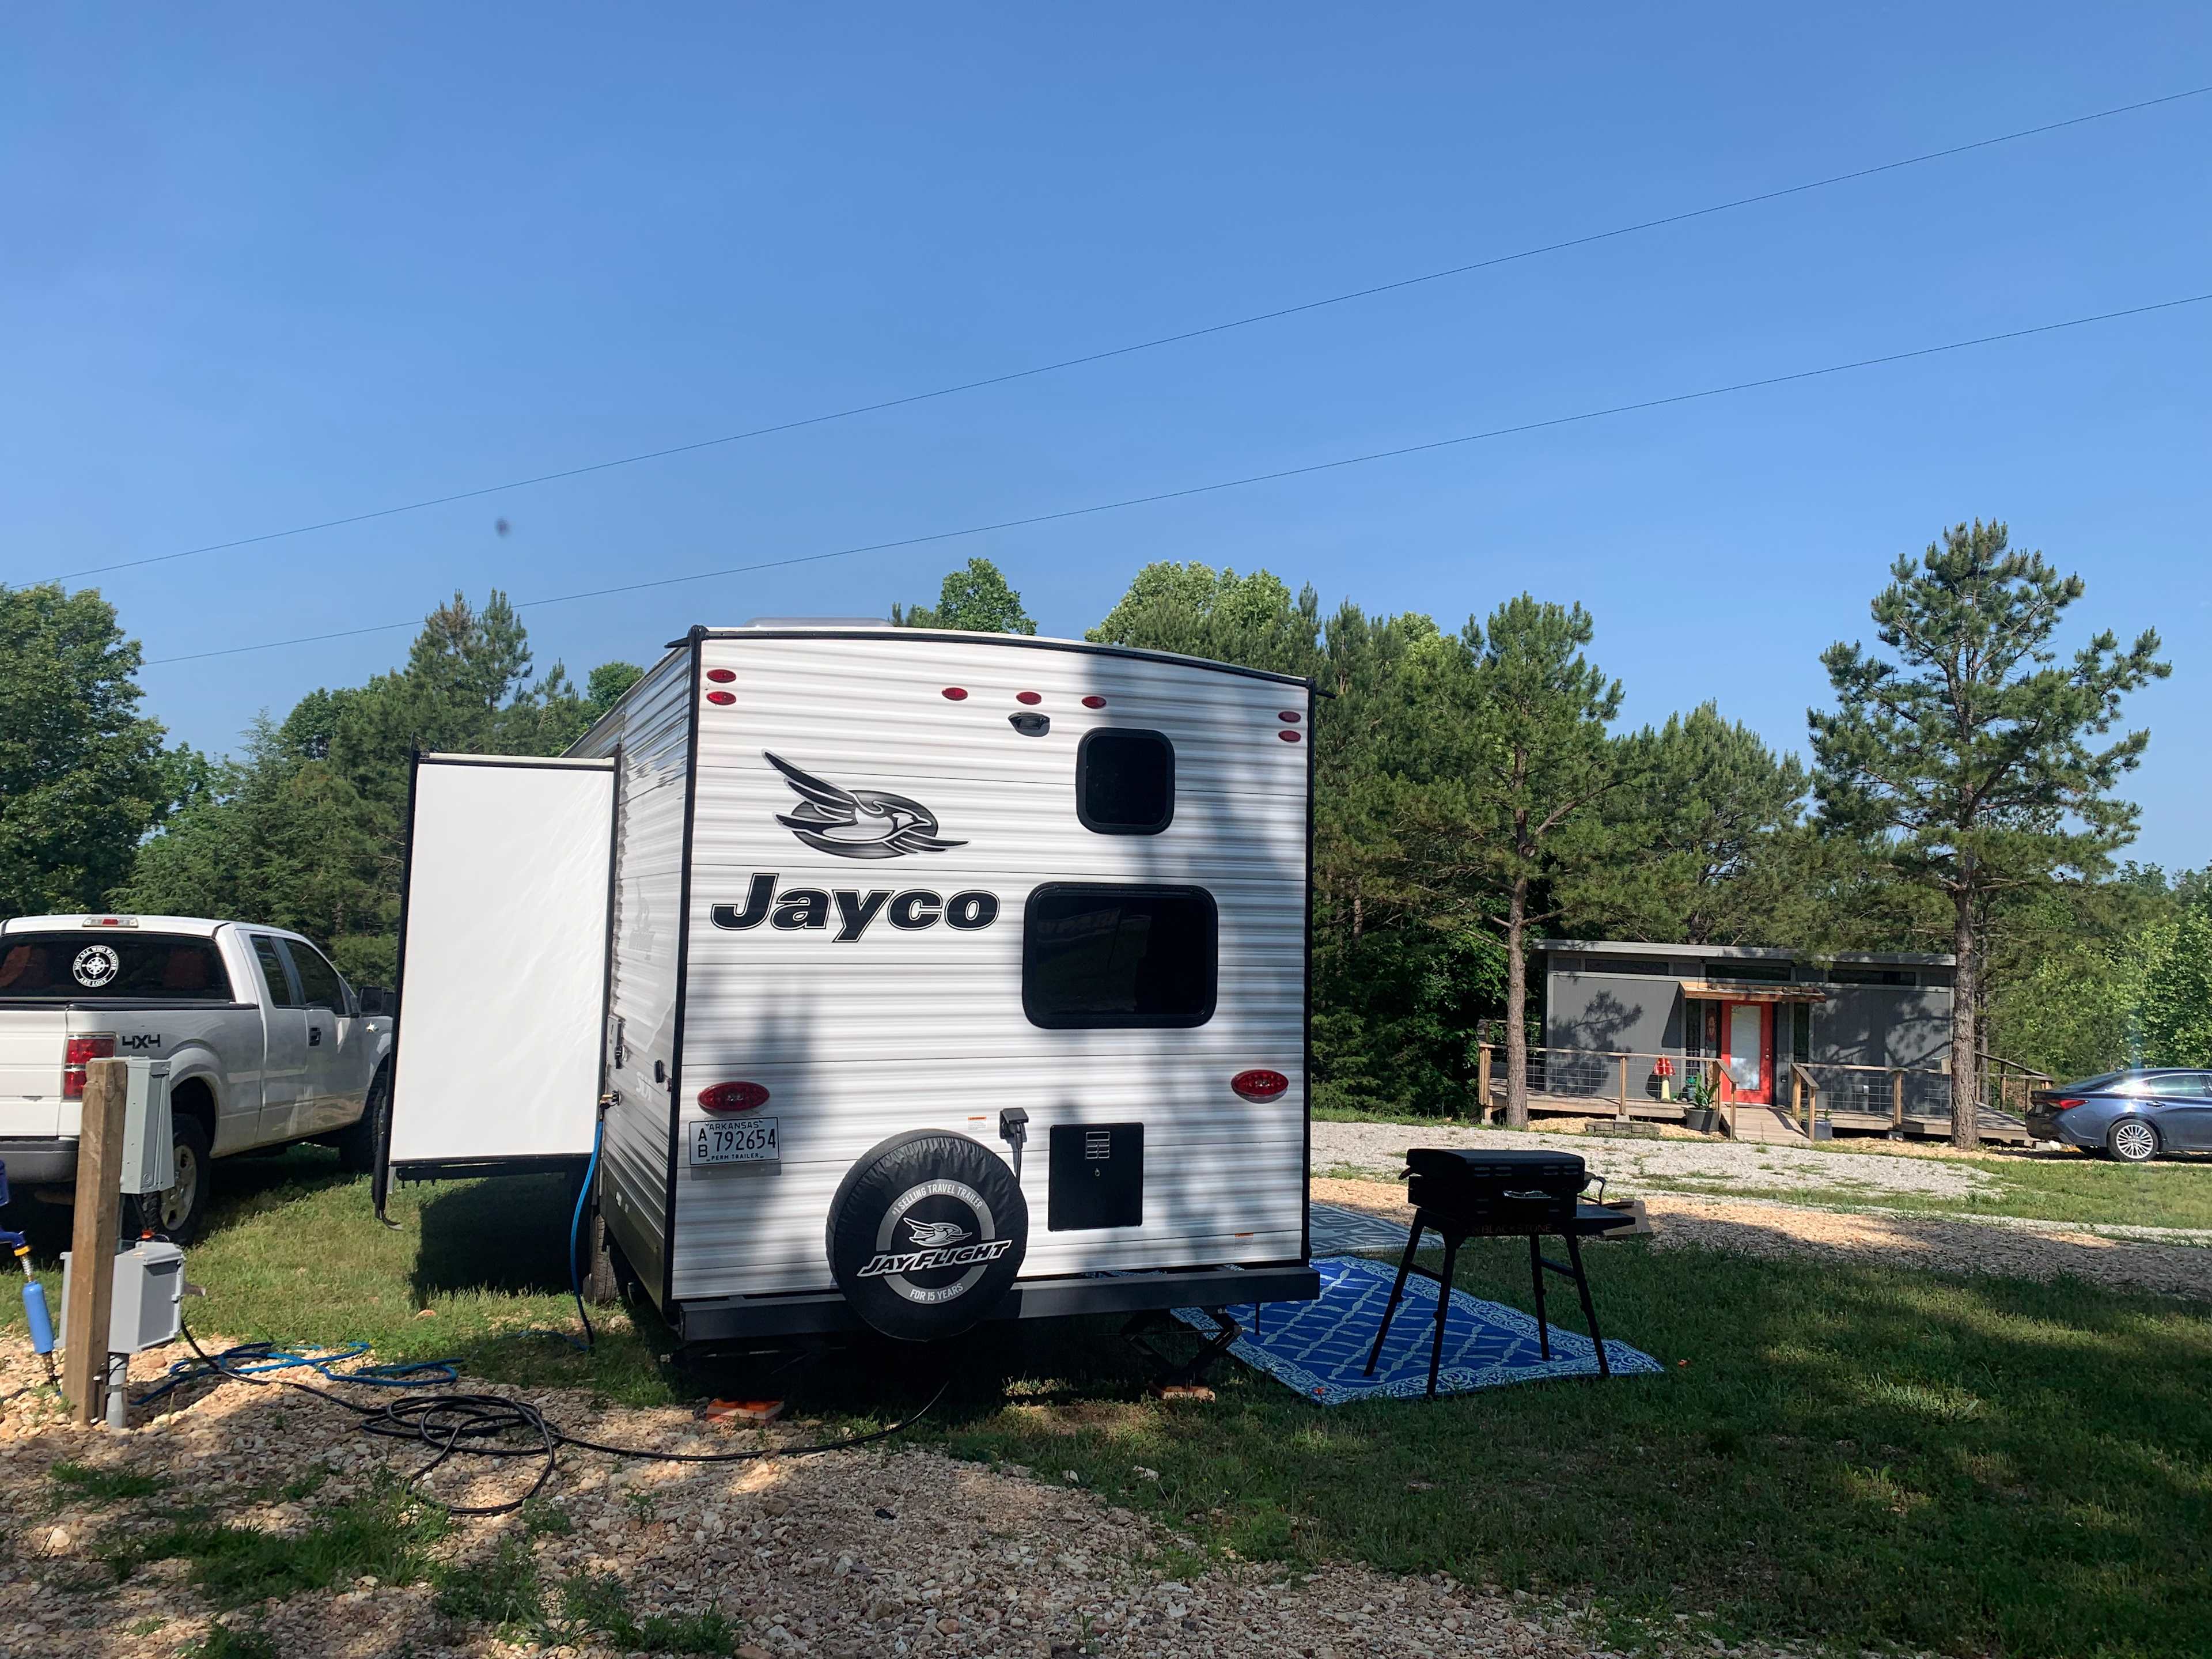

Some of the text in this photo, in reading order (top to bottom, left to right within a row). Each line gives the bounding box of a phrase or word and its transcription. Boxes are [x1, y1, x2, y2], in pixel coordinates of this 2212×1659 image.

[710, 873, 1000, 943] Jayco
[80, 949, 92, 959] ALL
[105, 949, 117, 971] WANDER
[79, 977, 107, 987] ARE LOST
[709, 1121, 759, 1131] ARKANSAS
[714, 1128, 776, 1152] 792654
[898, 1187, 926, 1211] SELLING
[927, 1184, 955, 1194] TRAVEL
[957, 1187, 983, 1210] TRAILER
[910, 1283, 964, 1301] FOR 15 YEARS
